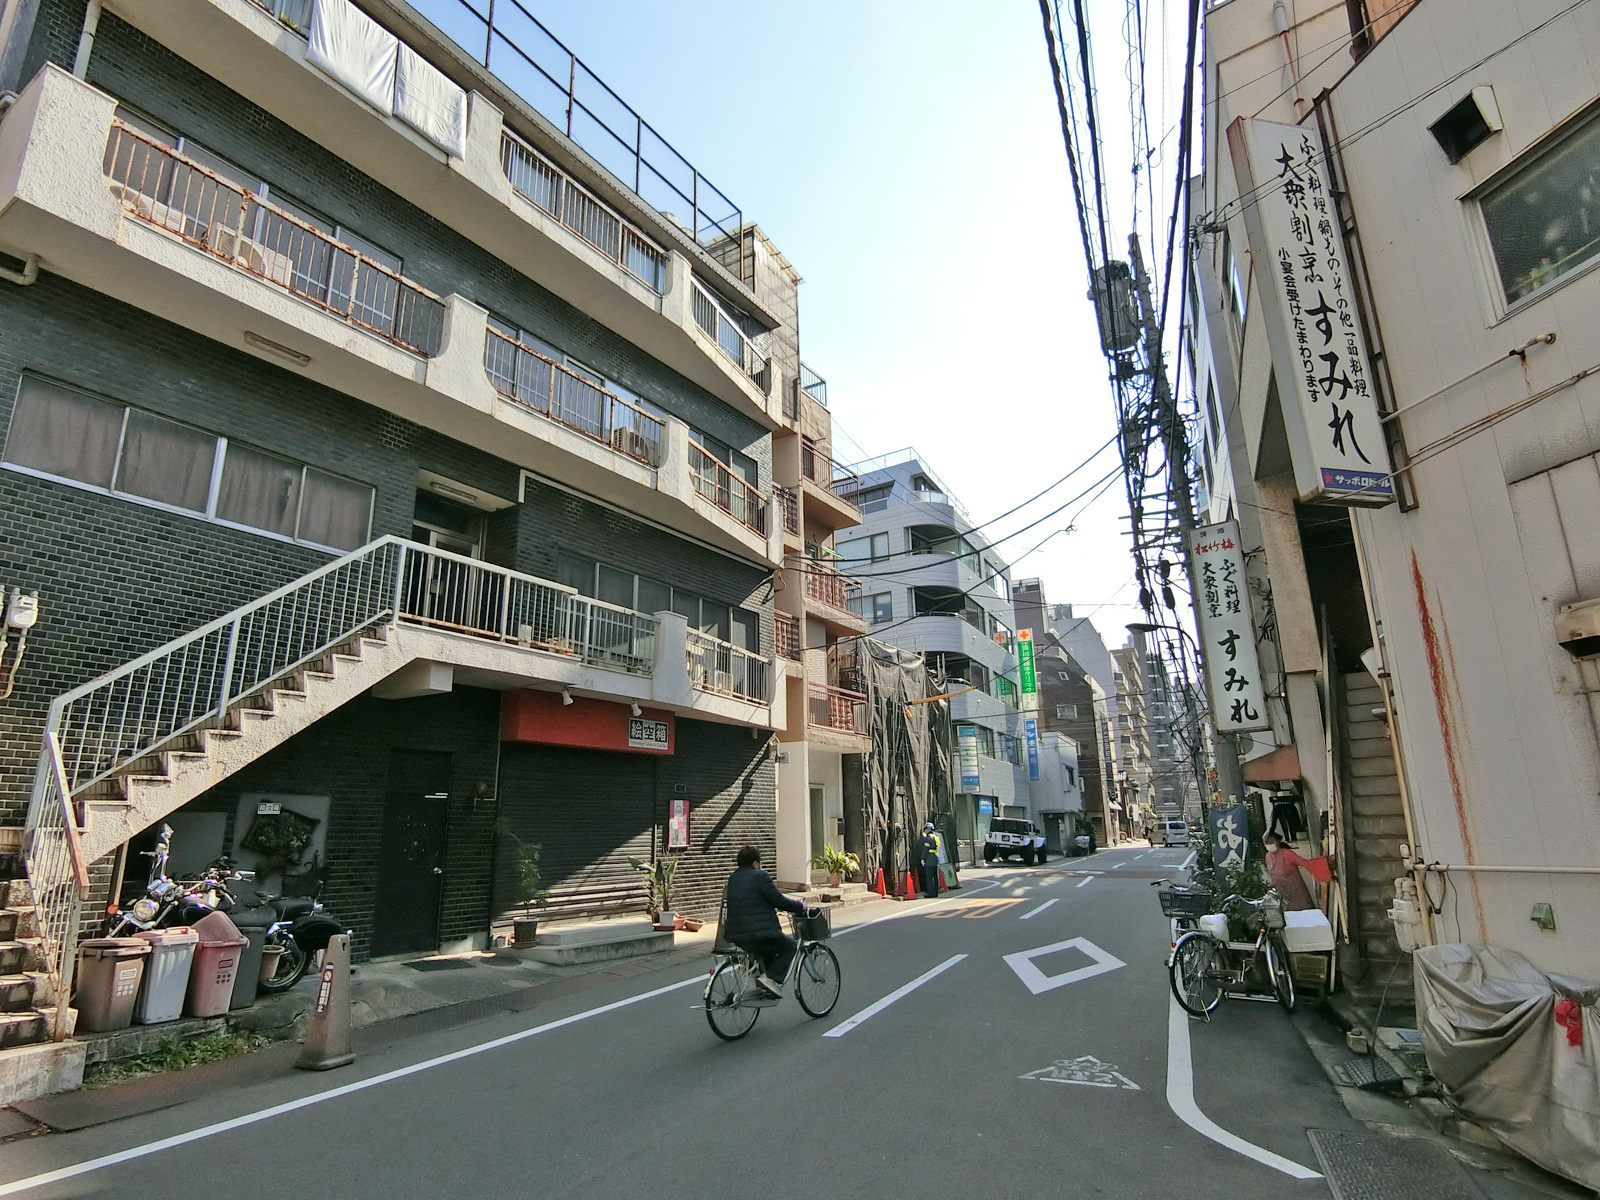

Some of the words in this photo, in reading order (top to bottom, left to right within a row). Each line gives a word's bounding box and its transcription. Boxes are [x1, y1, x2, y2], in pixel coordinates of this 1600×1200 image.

[1275, 142, 1324, 284] 大衆割烹
[1305, 290, 1371, 465] すみれ
[1278, 246, 1318, 403] 小宴会受けたまわります
[1334, 474, 1391, 488] サッポロビール
[1194, 537, 1235, 556] 松竹梅
[1202, 561, 1222, 618] 大衆割烹
[1219, 559, 1241, 614] ふぐ料理
[1217, 629, 1259, 722] すみれ
[630, 719, 668, 743] 絵空箱
